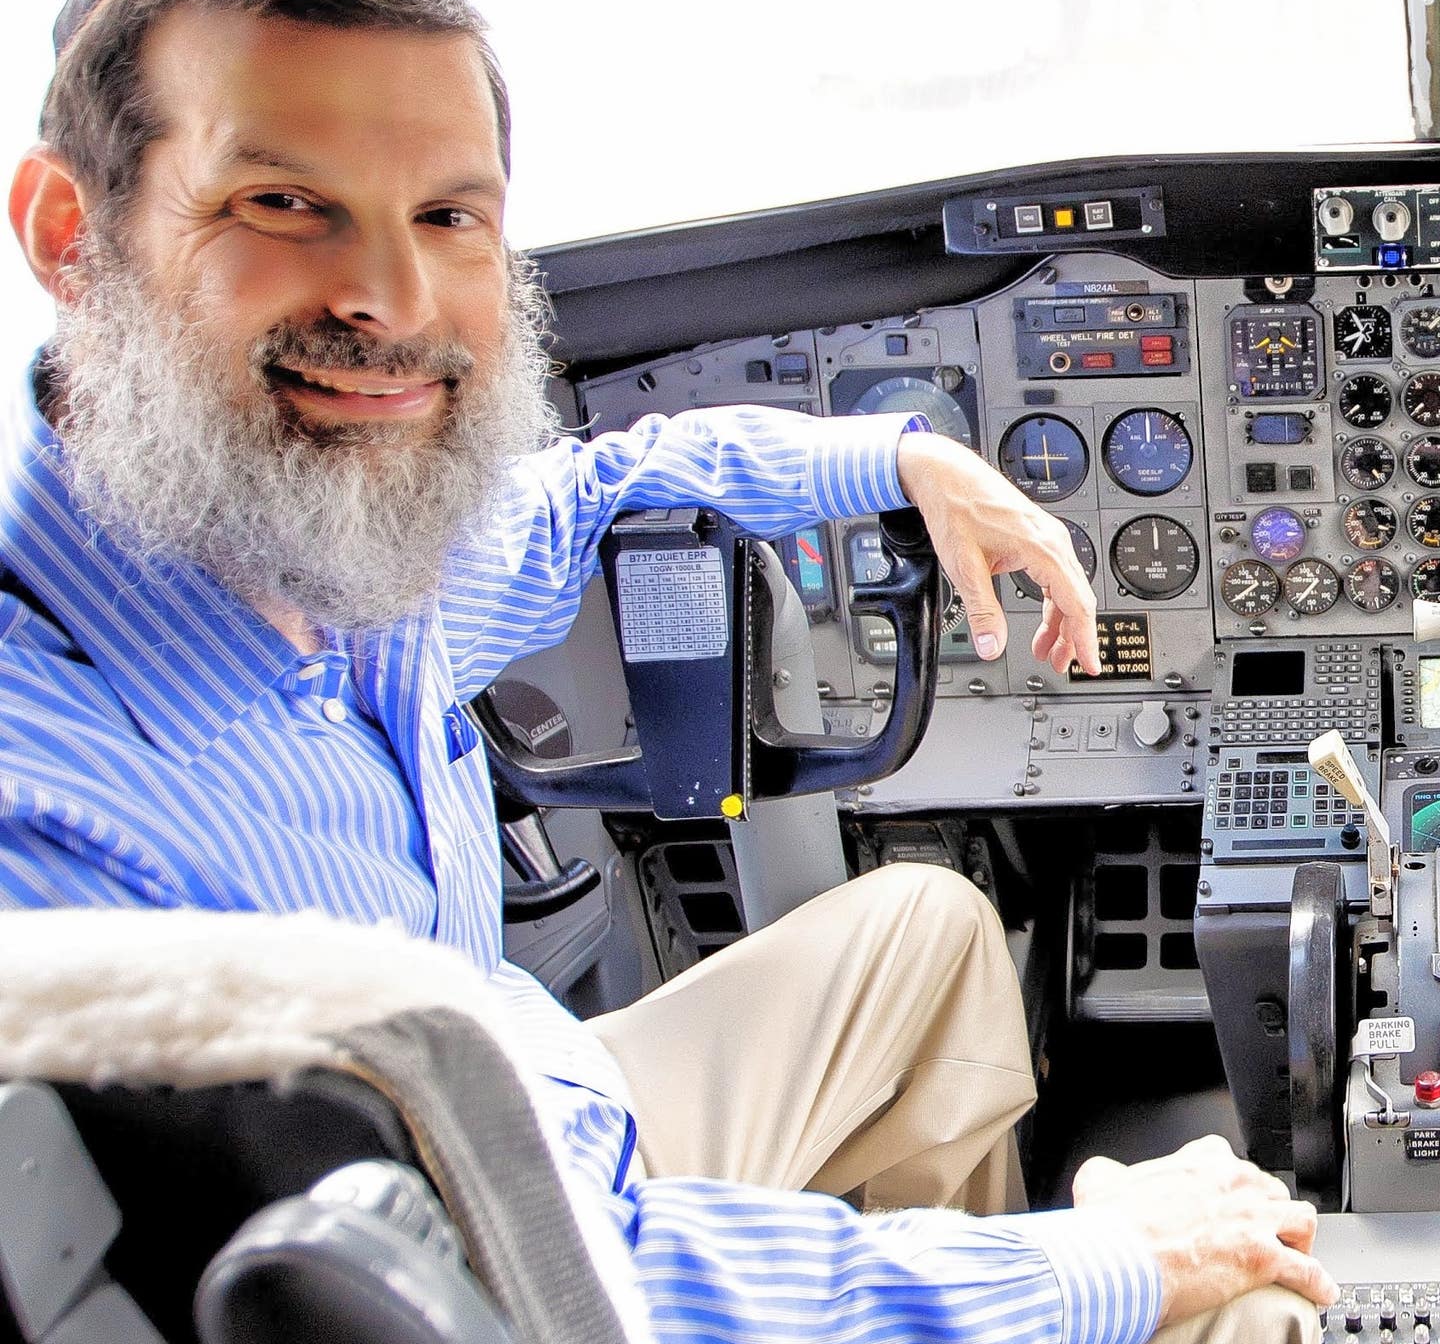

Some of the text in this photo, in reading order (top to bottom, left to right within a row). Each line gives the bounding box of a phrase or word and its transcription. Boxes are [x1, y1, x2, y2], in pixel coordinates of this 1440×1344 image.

[1083, 283, 1119, 293] N824AL
[1071, 333, 1092, 341] WELL
[629, 551, 707, 562] B737 QUIET EPR
[530, 714, 564, 738] CENTER
[1318, 765, 1339, 785] BRAKE
[1324, 760, 1347, 780] SPEED
[1368, 1020, 1411, 1030] PARKING
[1368, 1030, 1402, 1039] BRAKE
[1368, 1039, 1399, 1049] PULL
[1413, 1131, 1436, 1140] PARK
[1411, 1140, 1440, 1148] BRAKE
[1413, 1148, 1439, 1158] LIGHT
